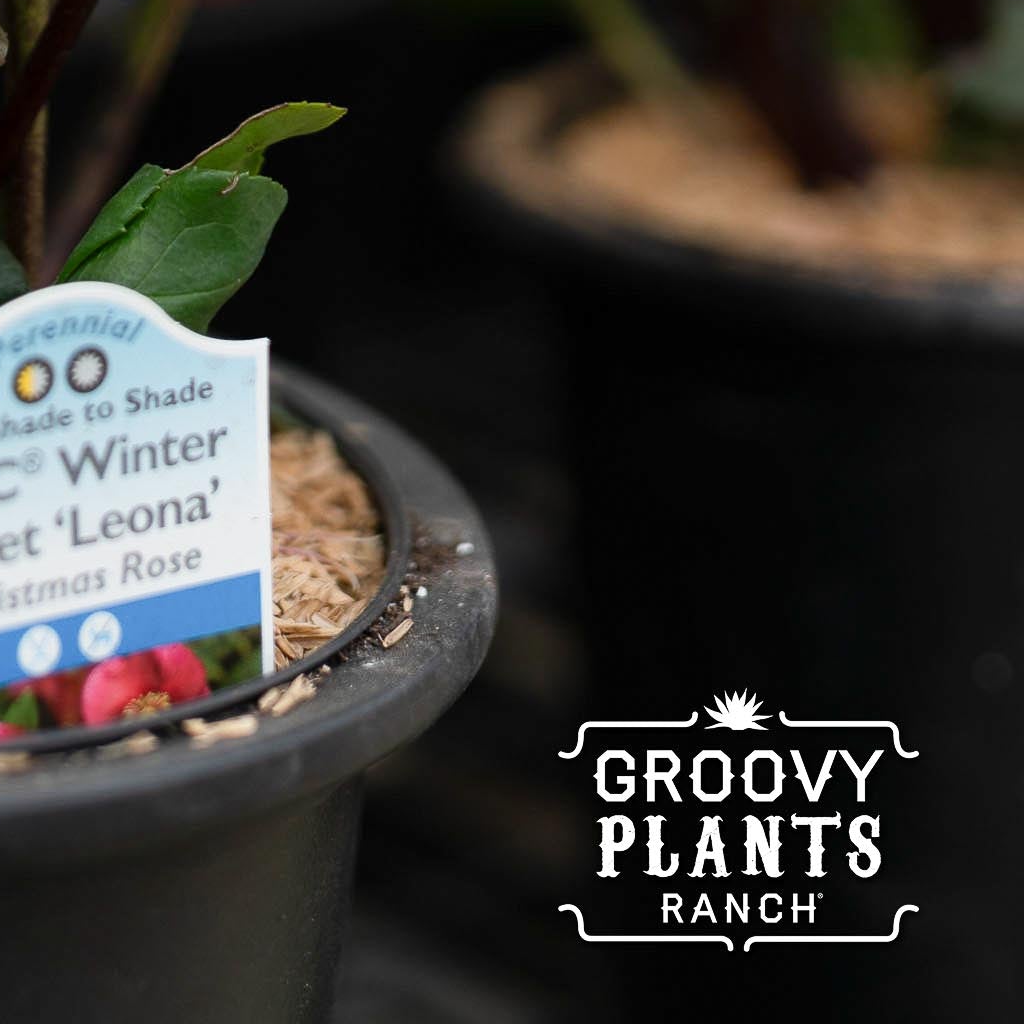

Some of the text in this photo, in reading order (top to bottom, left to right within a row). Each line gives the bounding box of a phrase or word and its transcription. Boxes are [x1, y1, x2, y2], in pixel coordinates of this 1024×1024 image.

[85, 398, 113, 422] to
[126, 378, 213, 413] Shade
[59, 428, 228, 485] Winter
[123, 548, 202, 583] Rose
